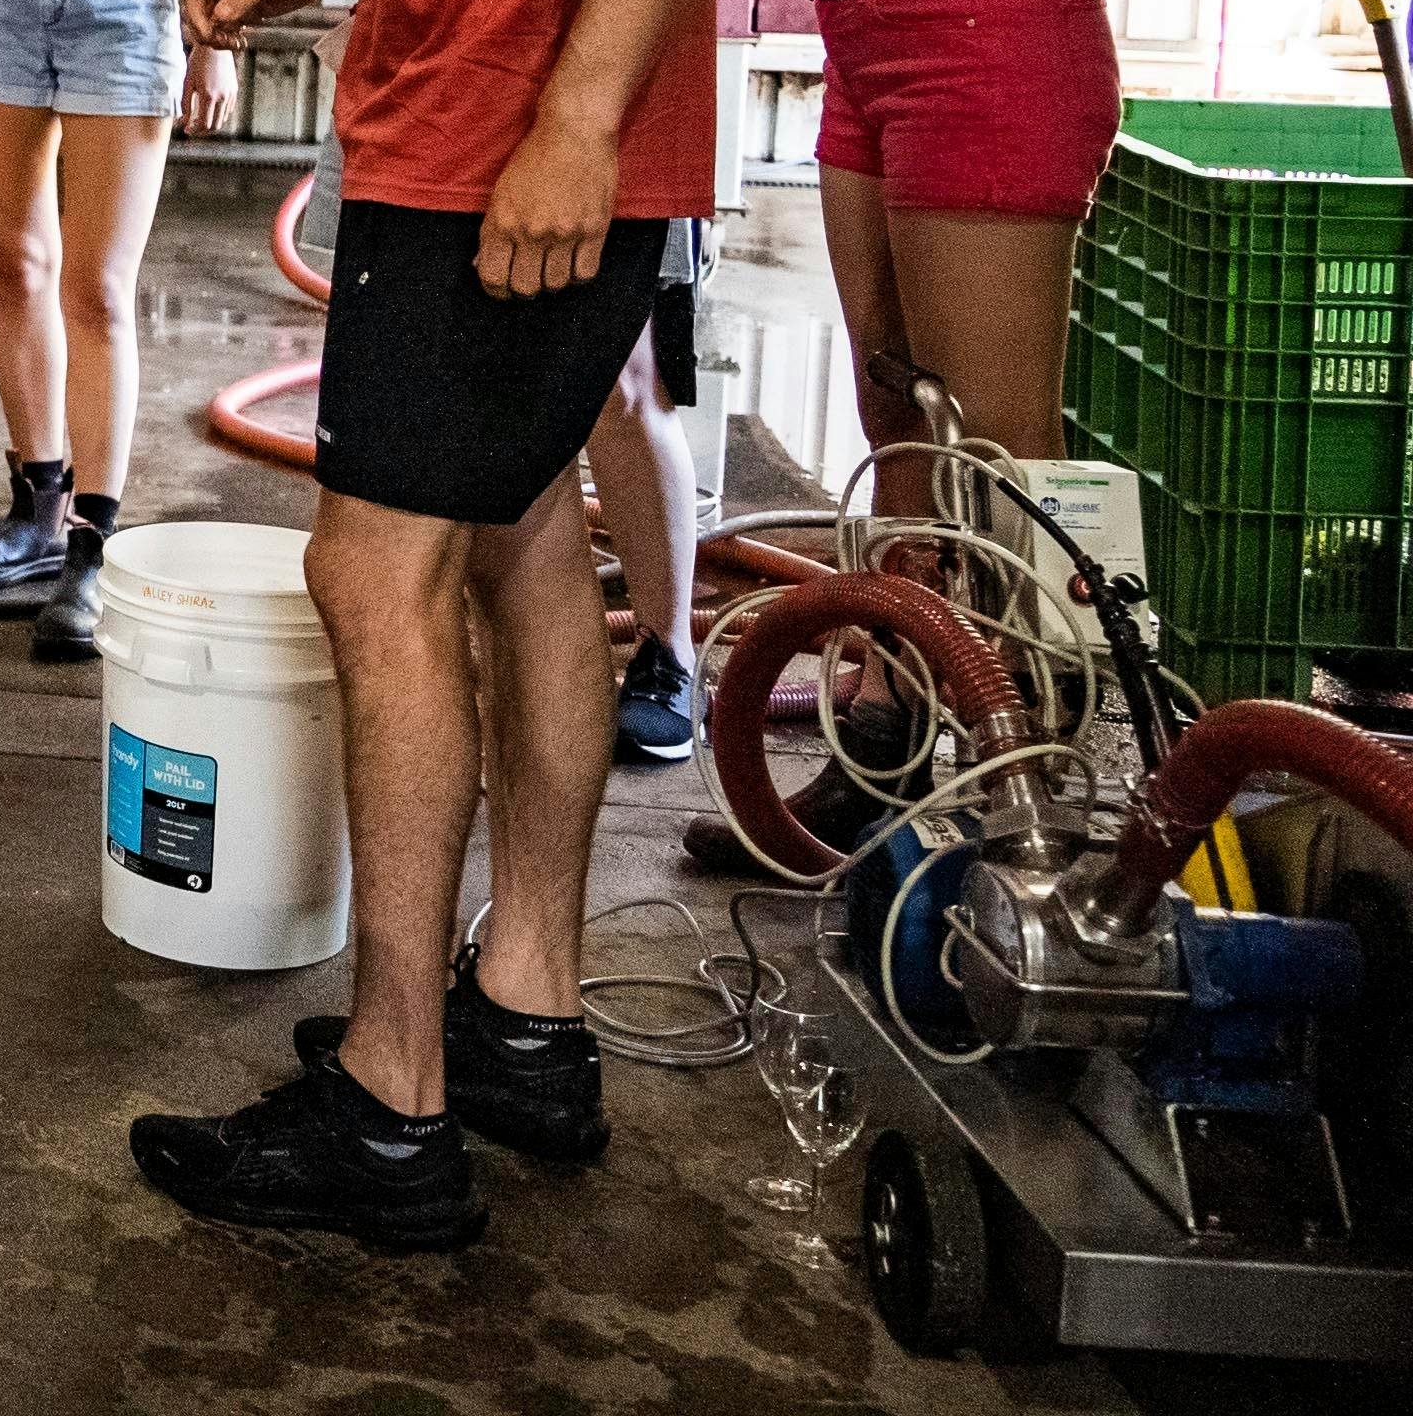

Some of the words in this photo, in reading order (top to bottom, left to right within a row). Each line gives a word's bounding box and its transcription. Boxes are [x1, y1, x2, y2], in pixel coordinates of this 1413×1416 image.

[176, 593, 217, 610] SHIRAZ
[164, 760, 192, 777] PAIL
[153, 769, 183, 787] WITH
[185, 776, 205, 791] LID
